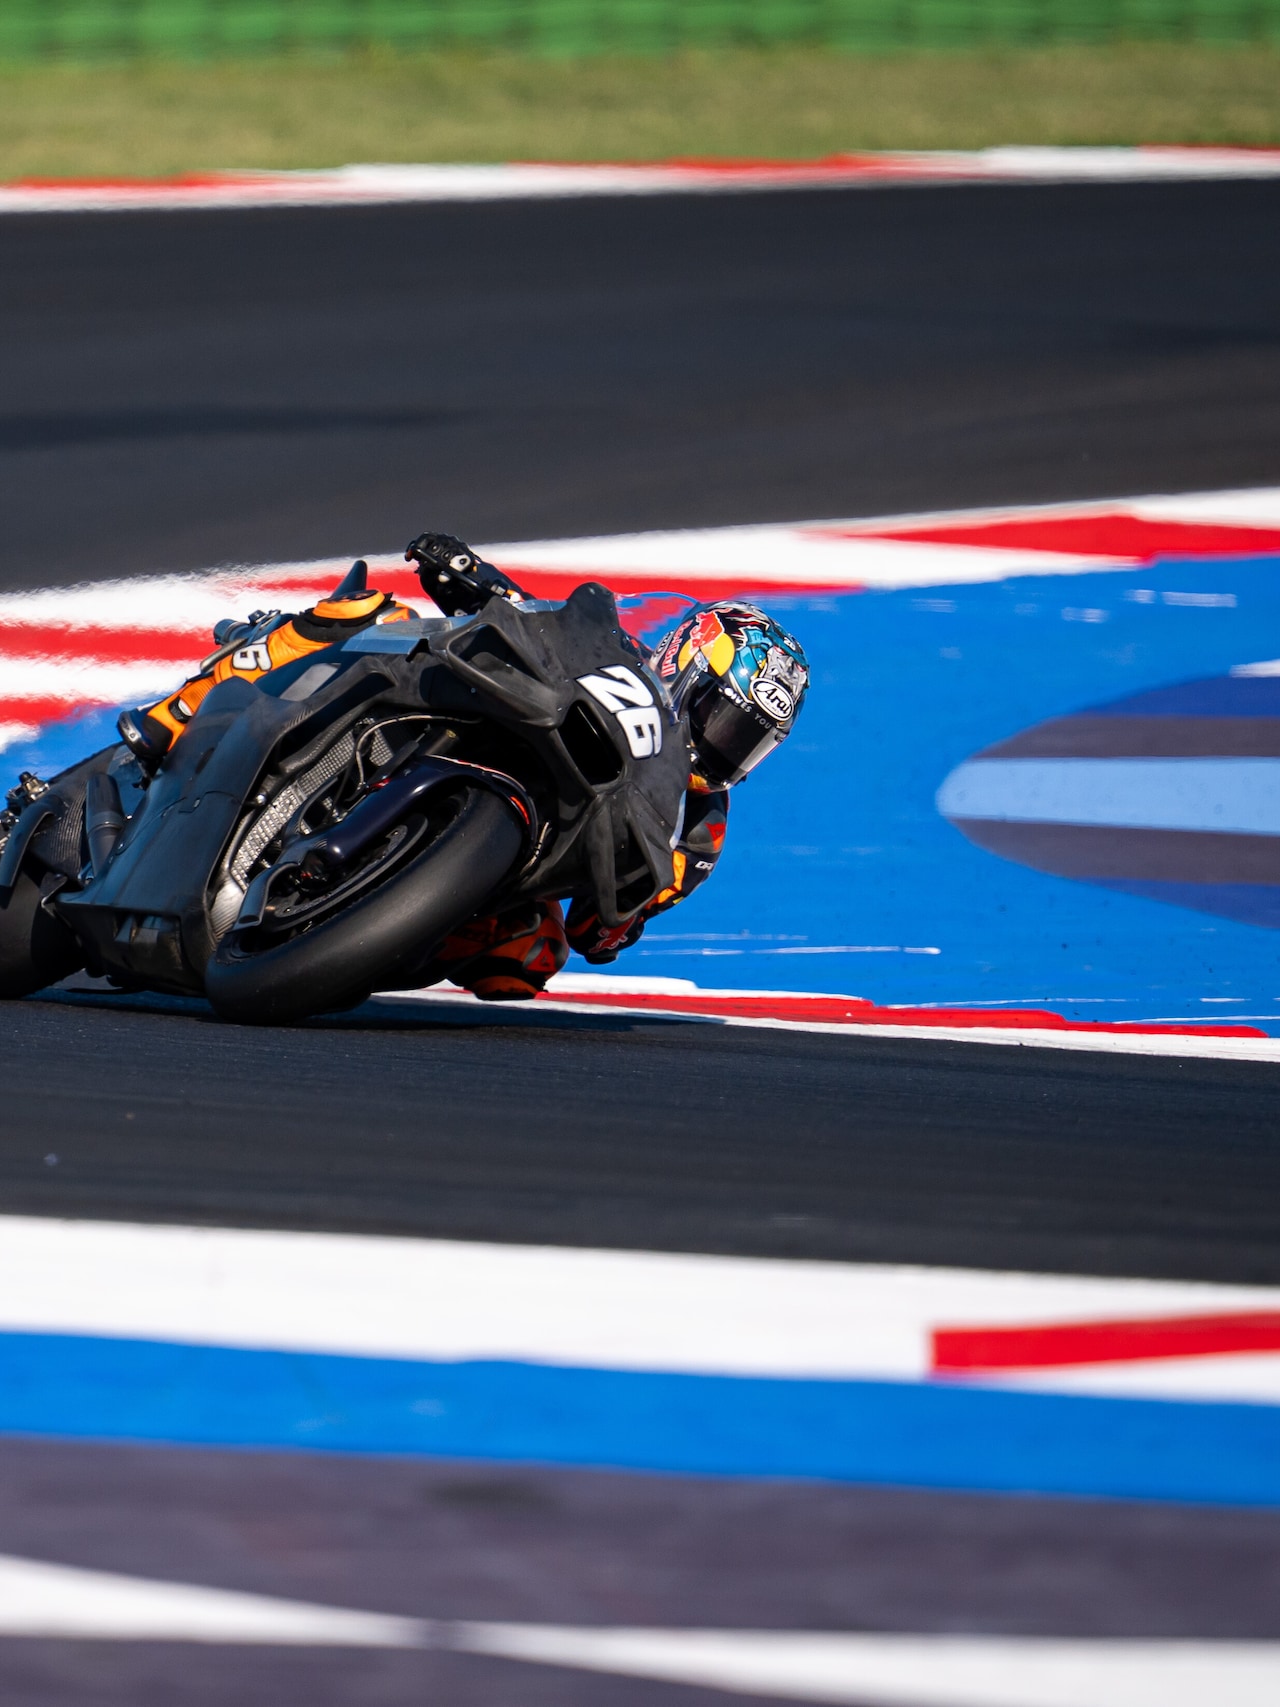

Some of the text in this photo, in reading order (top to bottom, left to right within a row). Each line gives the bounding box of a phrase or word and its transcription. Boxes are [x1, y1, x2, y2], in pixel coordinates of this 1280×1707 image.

[579, 664, 662, 759] 26
[755, 687, 791, 715] Arai
[754, 713, 772, 729] YOU
